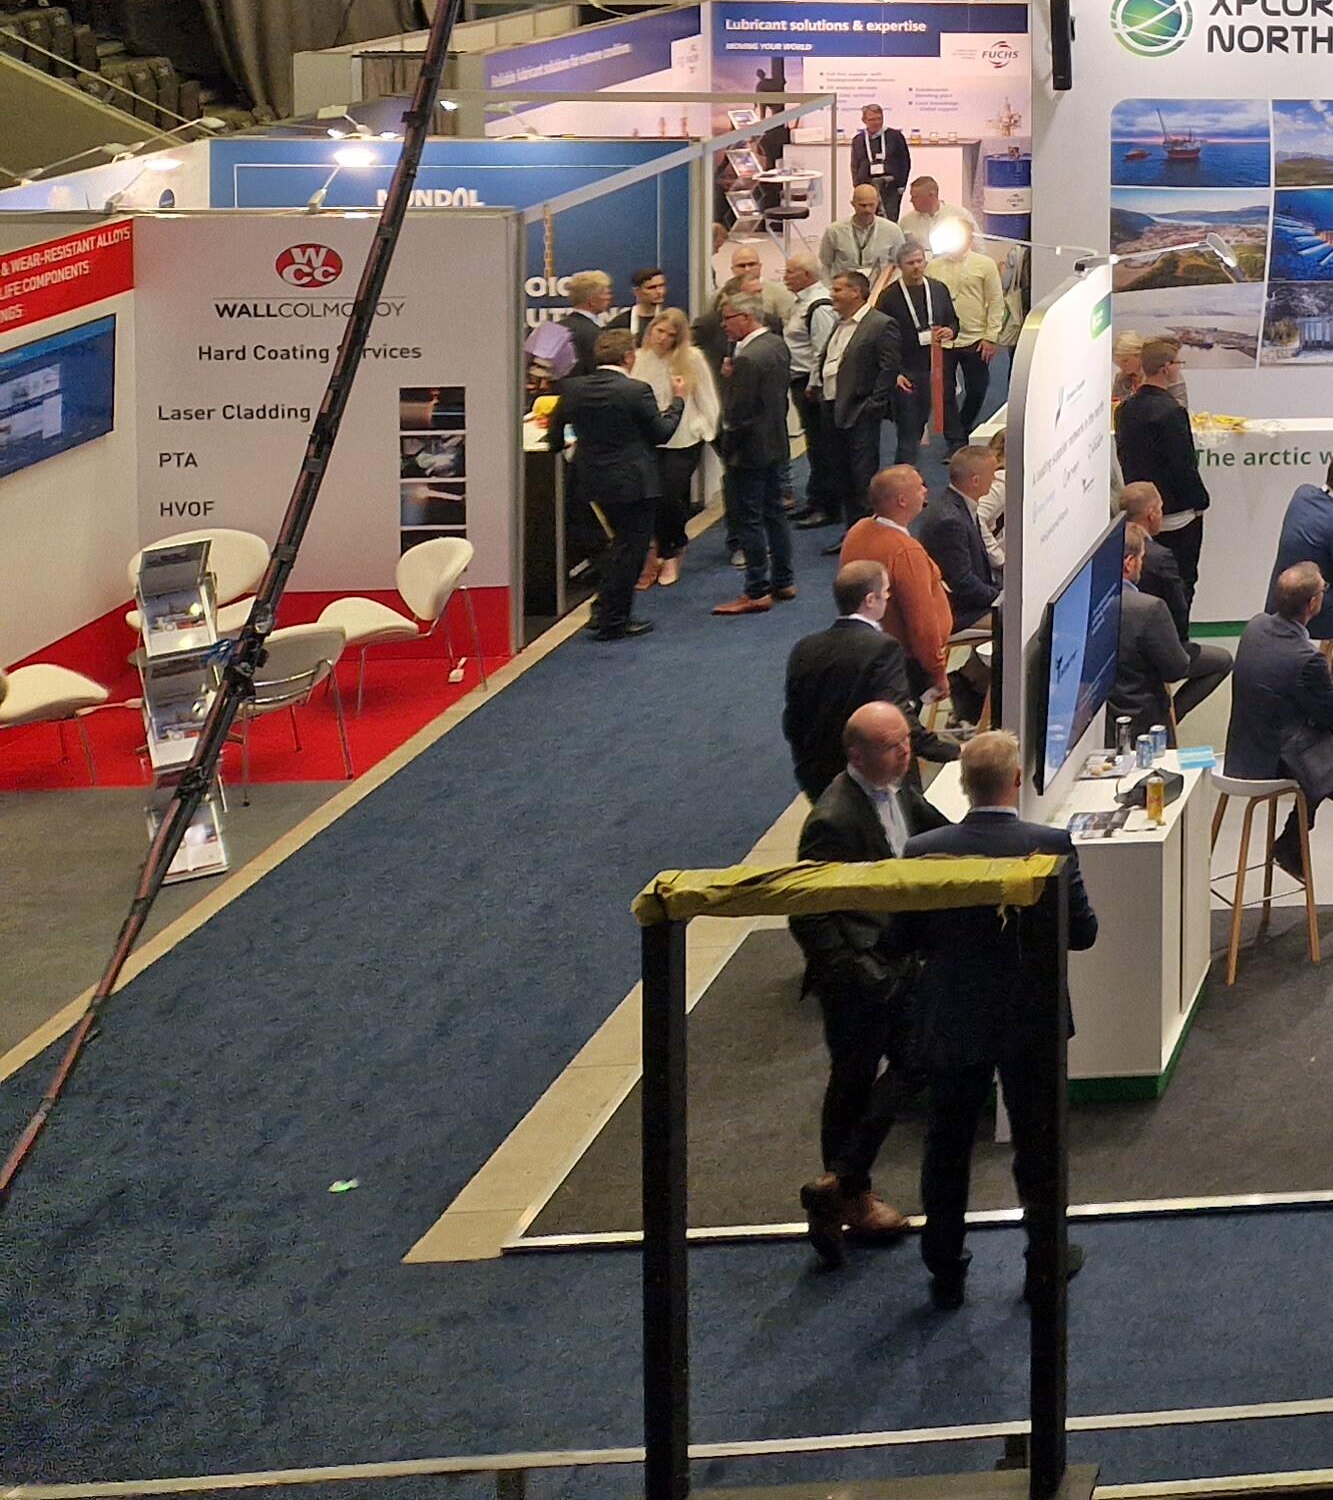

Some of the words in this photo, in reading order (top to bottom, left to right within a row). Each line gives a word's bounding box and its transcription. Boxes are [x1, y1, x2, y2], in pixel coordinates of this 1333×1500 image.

[725, 19, 787, 32] Lubricant
[789, 19, 850, 32] solutions
[852, 20, 863, 32] &
[866, 20, 927, 34] expertise
[725, 42, 759, 50] MOVING
[760, 42, 783, 50] YOUR
[783, 42, 813, 50] WORLD
[1206, 25, 1333, 54] NORTH
[981, 50, 1019, 59] FUCHS
[1, 261, 11, 276] &
[10, 236, 96, 272] WEAR-RESISTANT
[97, 226, 131, 248] ALLOYS
[23, 260, 90, 292] COMPONENTS
[214, 302, 406, 318] WALLCOLMOOY
[198, 345, 247, 361] Hard
[253, 345, 330, 363] Coating
[338, 344, 422, 360] rvices
[158, 405, 216, 421] Laser
[222, 404, 311, 422] Cladding
[159, 453, 198, 468] PTA
[1194, 449, 1235, 466] The
[1244, 447, 1312, 466] arctic
[160, 501, 215, 517] HVOF
